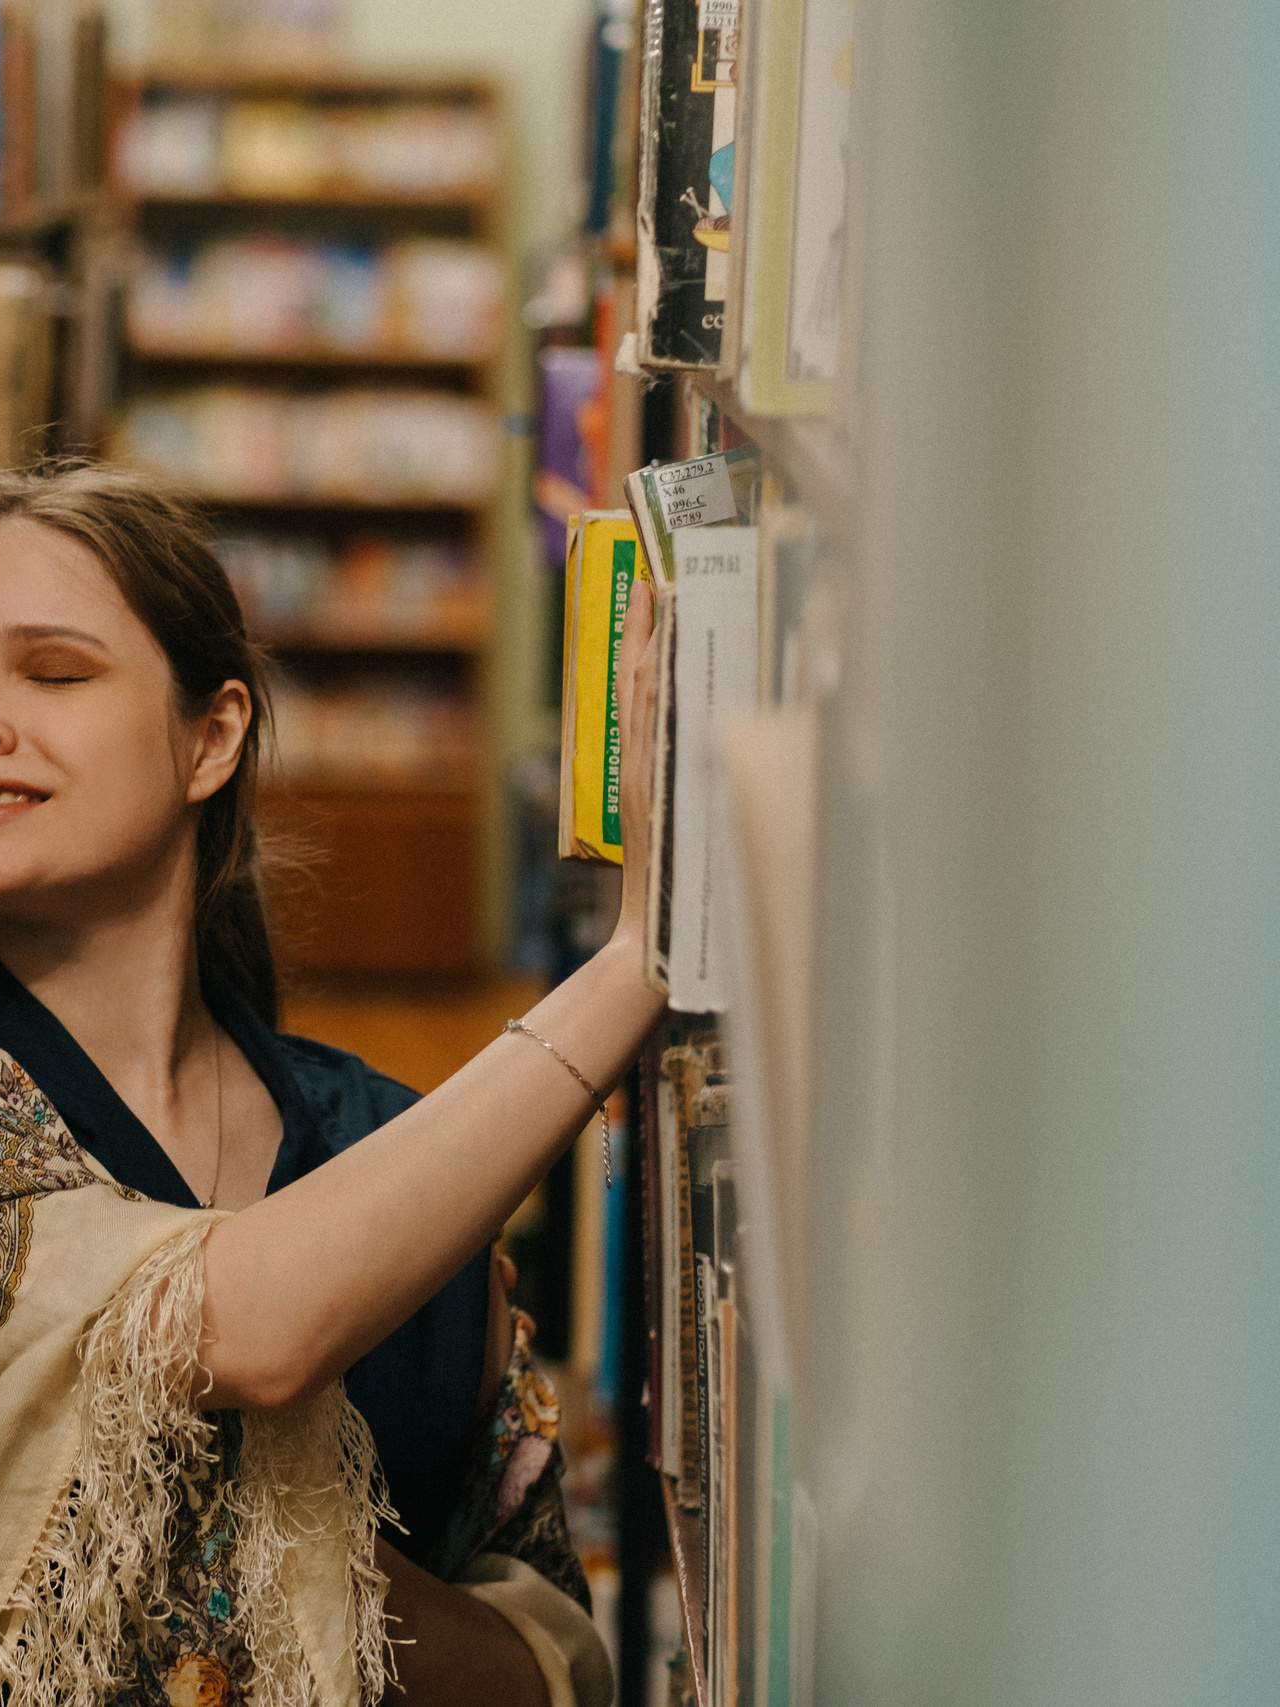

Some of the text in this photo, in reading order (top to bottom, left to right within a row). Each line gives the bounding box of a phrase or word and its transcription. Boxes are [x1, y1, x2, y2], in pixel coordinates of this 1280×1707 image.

[669, 511, 702, 528] 05789
[614, 571, 629, 633] СОВЕТЫ
[607, 726, 621, 814] СТРОИТЕЛЯ
[696, 1264, 707, 1377] ПРОЦЕССОВ
[697, 1386, 708, 1484] ПЕЧАТНЫХ
